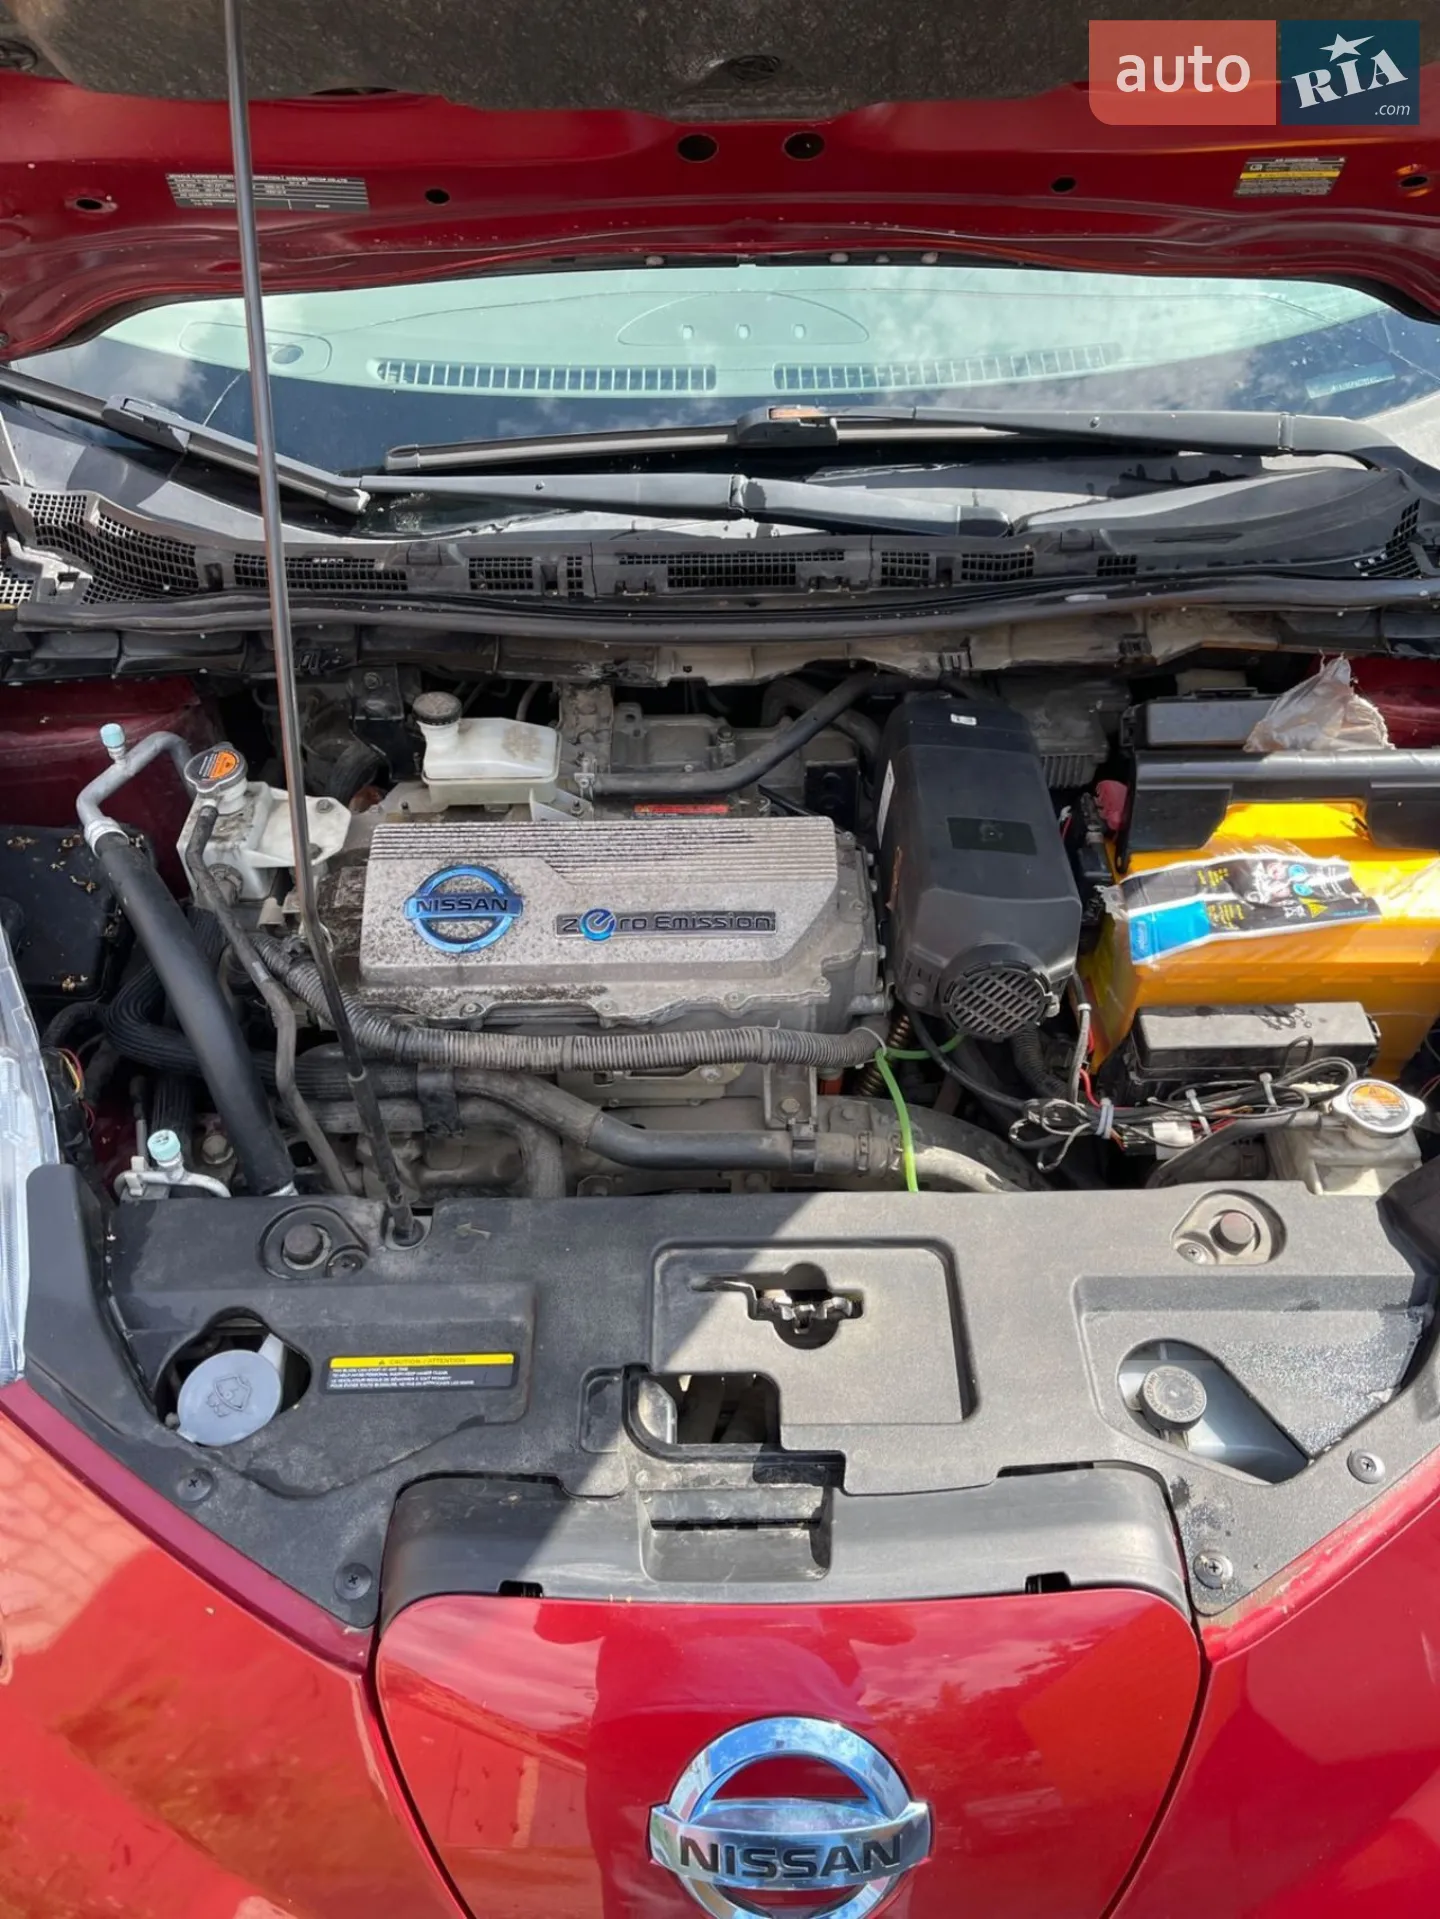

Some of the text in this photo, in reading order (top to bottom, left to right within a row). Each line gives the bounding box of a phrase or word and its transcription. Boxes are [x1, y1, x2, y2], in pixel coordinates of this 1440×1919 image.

[416, 898, 508, 913] NISSAN
[655, 912, 771, 930] Emission
[679, 1835, 901, 1880] NISSAN
